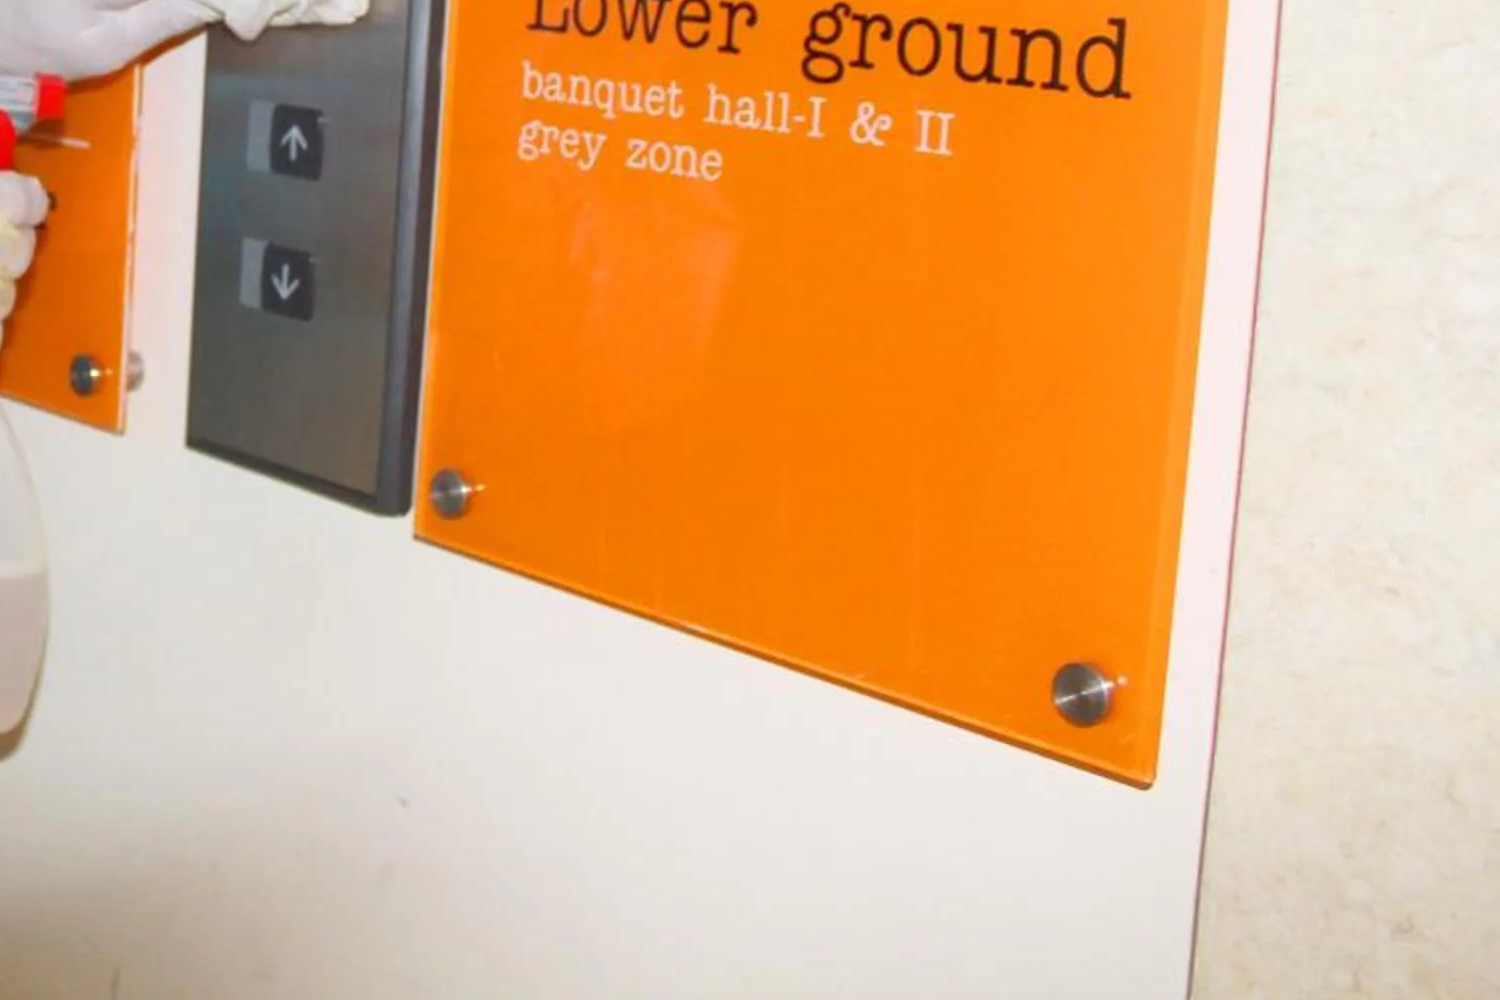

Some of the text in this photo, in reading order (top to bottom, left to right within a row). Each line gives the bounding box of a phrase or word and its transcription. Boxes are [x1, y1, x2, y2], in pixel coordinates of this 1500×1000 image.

[800, 1, 1133, 100] ground
[517, 119, 724, 182] grey zone
[522, 60, 955, 156] banquet hall-I & II
